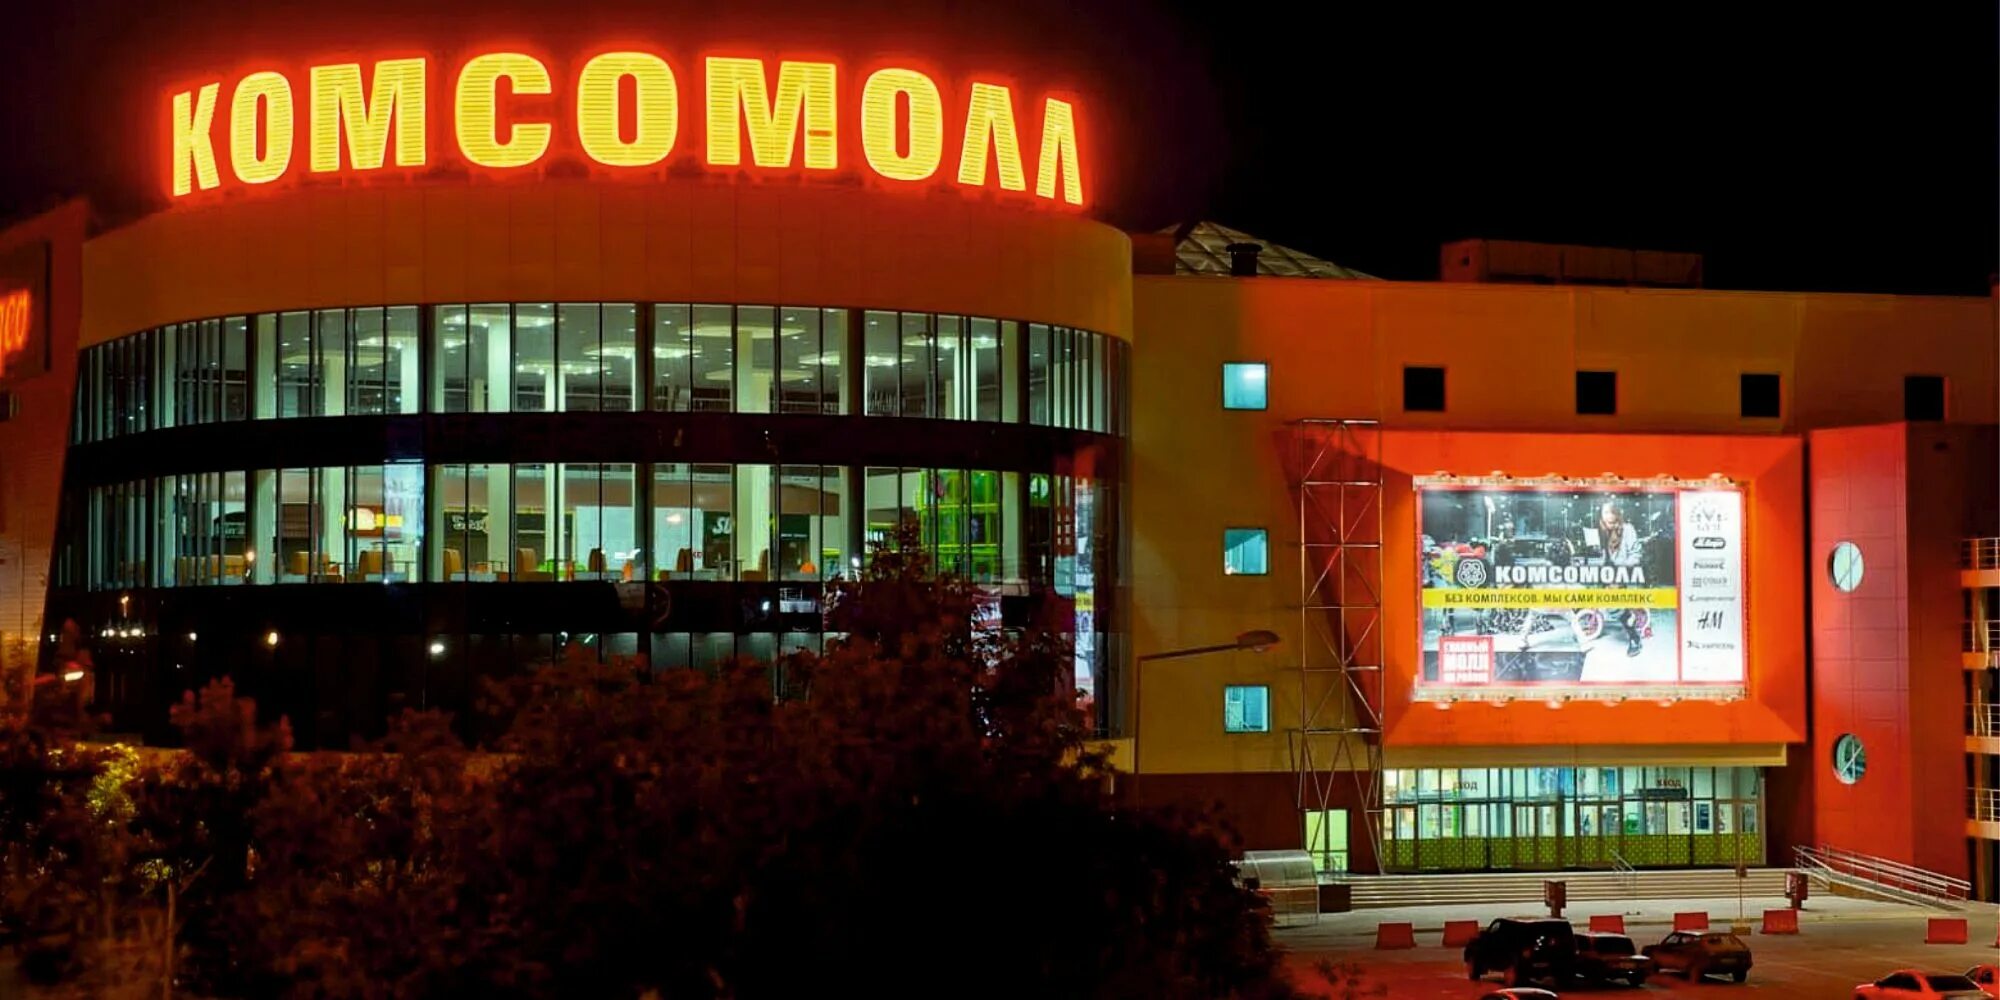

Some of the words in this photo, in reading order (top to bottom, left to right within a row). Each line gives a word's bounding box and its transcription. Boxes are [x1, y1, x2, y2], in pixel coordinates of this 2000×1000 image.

[171, 50, 1084, 206] КОМСОМОЛЛ
[1495, 565, 1646, 584] КОМСОМОЛЛ
[1444, 593, 1463, 603] БЕЗ
[1465, 593, 1540, 603] КОМПЛЕКСОВ.
[1543, 593, 1562, 603] МЫ
[1564, 593, 1594, 603] САМИ
[1595, 593, 1656, 603] КОМПЛЕКС.
